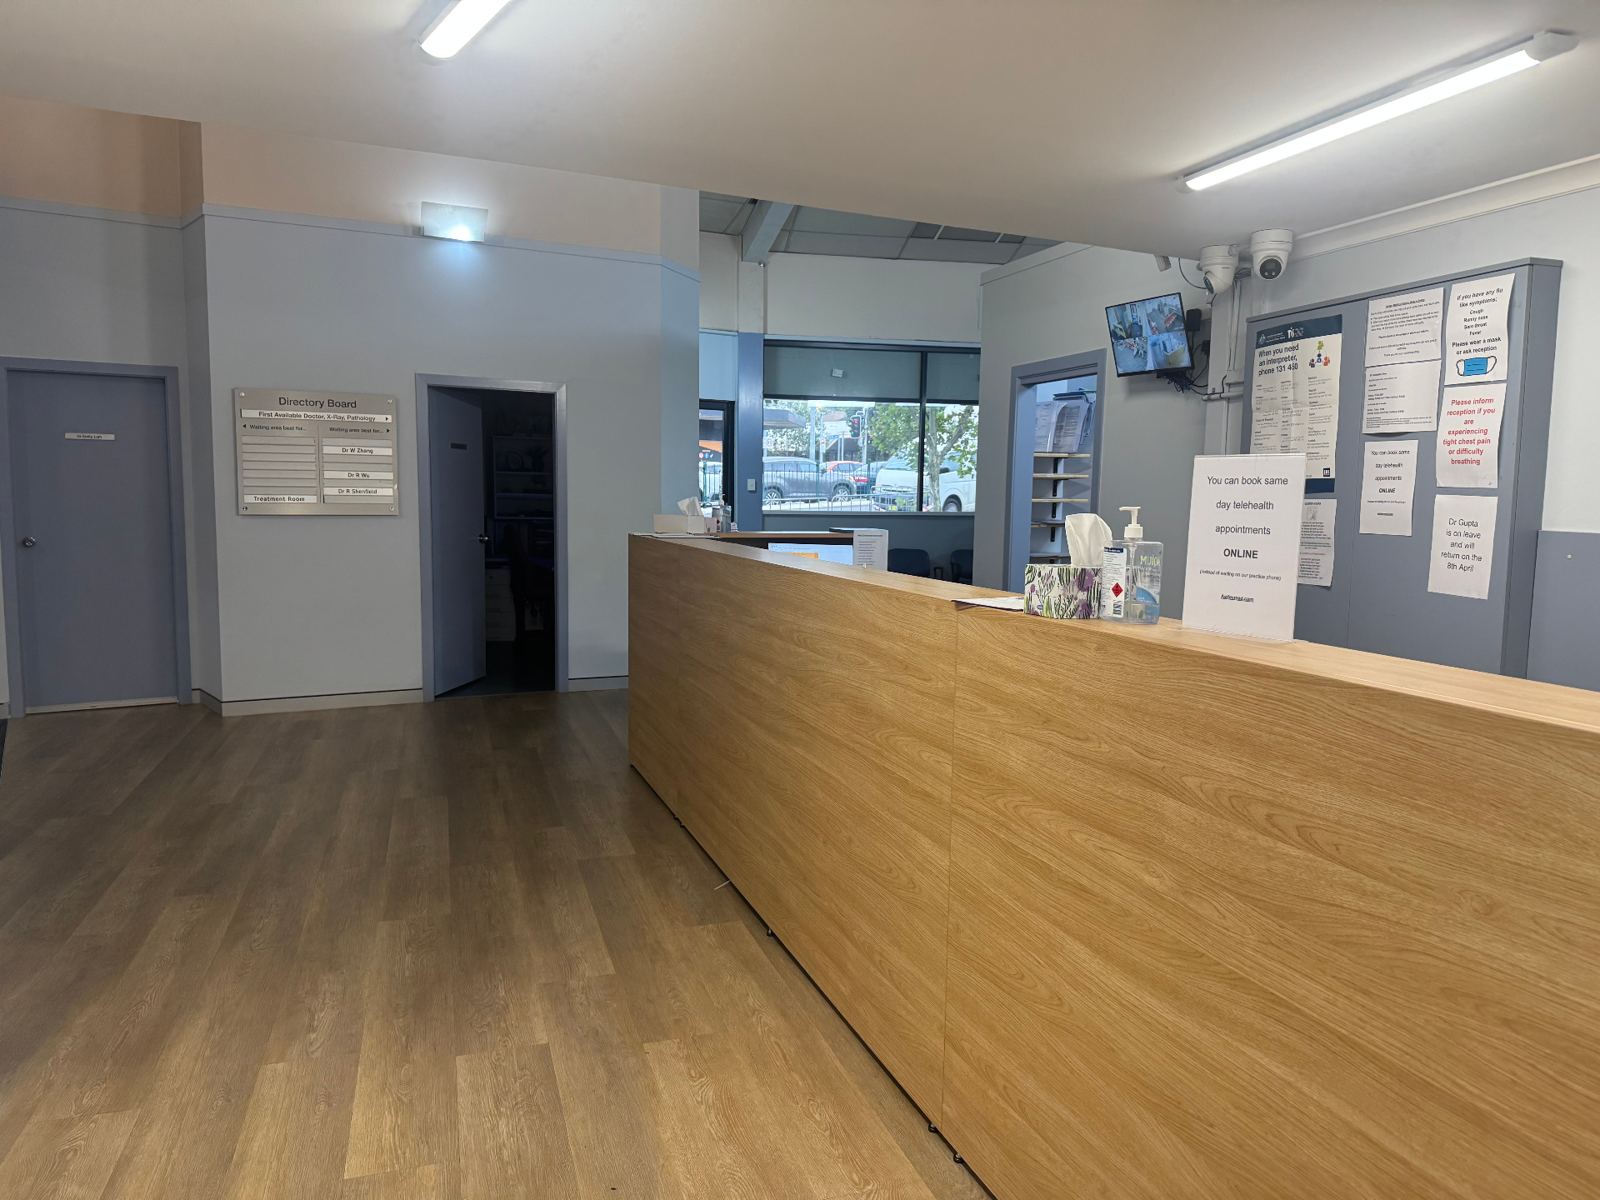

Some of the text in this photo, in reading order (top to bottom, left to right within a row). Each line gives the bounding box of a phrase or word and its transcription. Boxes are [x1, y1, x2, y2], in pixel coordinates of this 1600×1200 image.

[1259, 343, 1299, 358] When you need
[1266, 355, 1298, 365] interpreter,
[1258, 368, 1274, 376] phone
[1276, 364, 1286, 373] 131
[279, 397, 356, 408] Directory Board
[1448, 428, 1488, 436] experiencing
[1208, 476, 1222, 484] You
[1242, 476, 1262, 484] book
[1216, 500, 1274, 510] day telehealth
[1458, 518, 1478, 527] Gupta
[1216, 525, 1271, 534] appointments
[1463, 530, 1481, 539] leave
[1224, 548, 1258, 558] ONLINE
[1459, 564, 1474, 572] April
